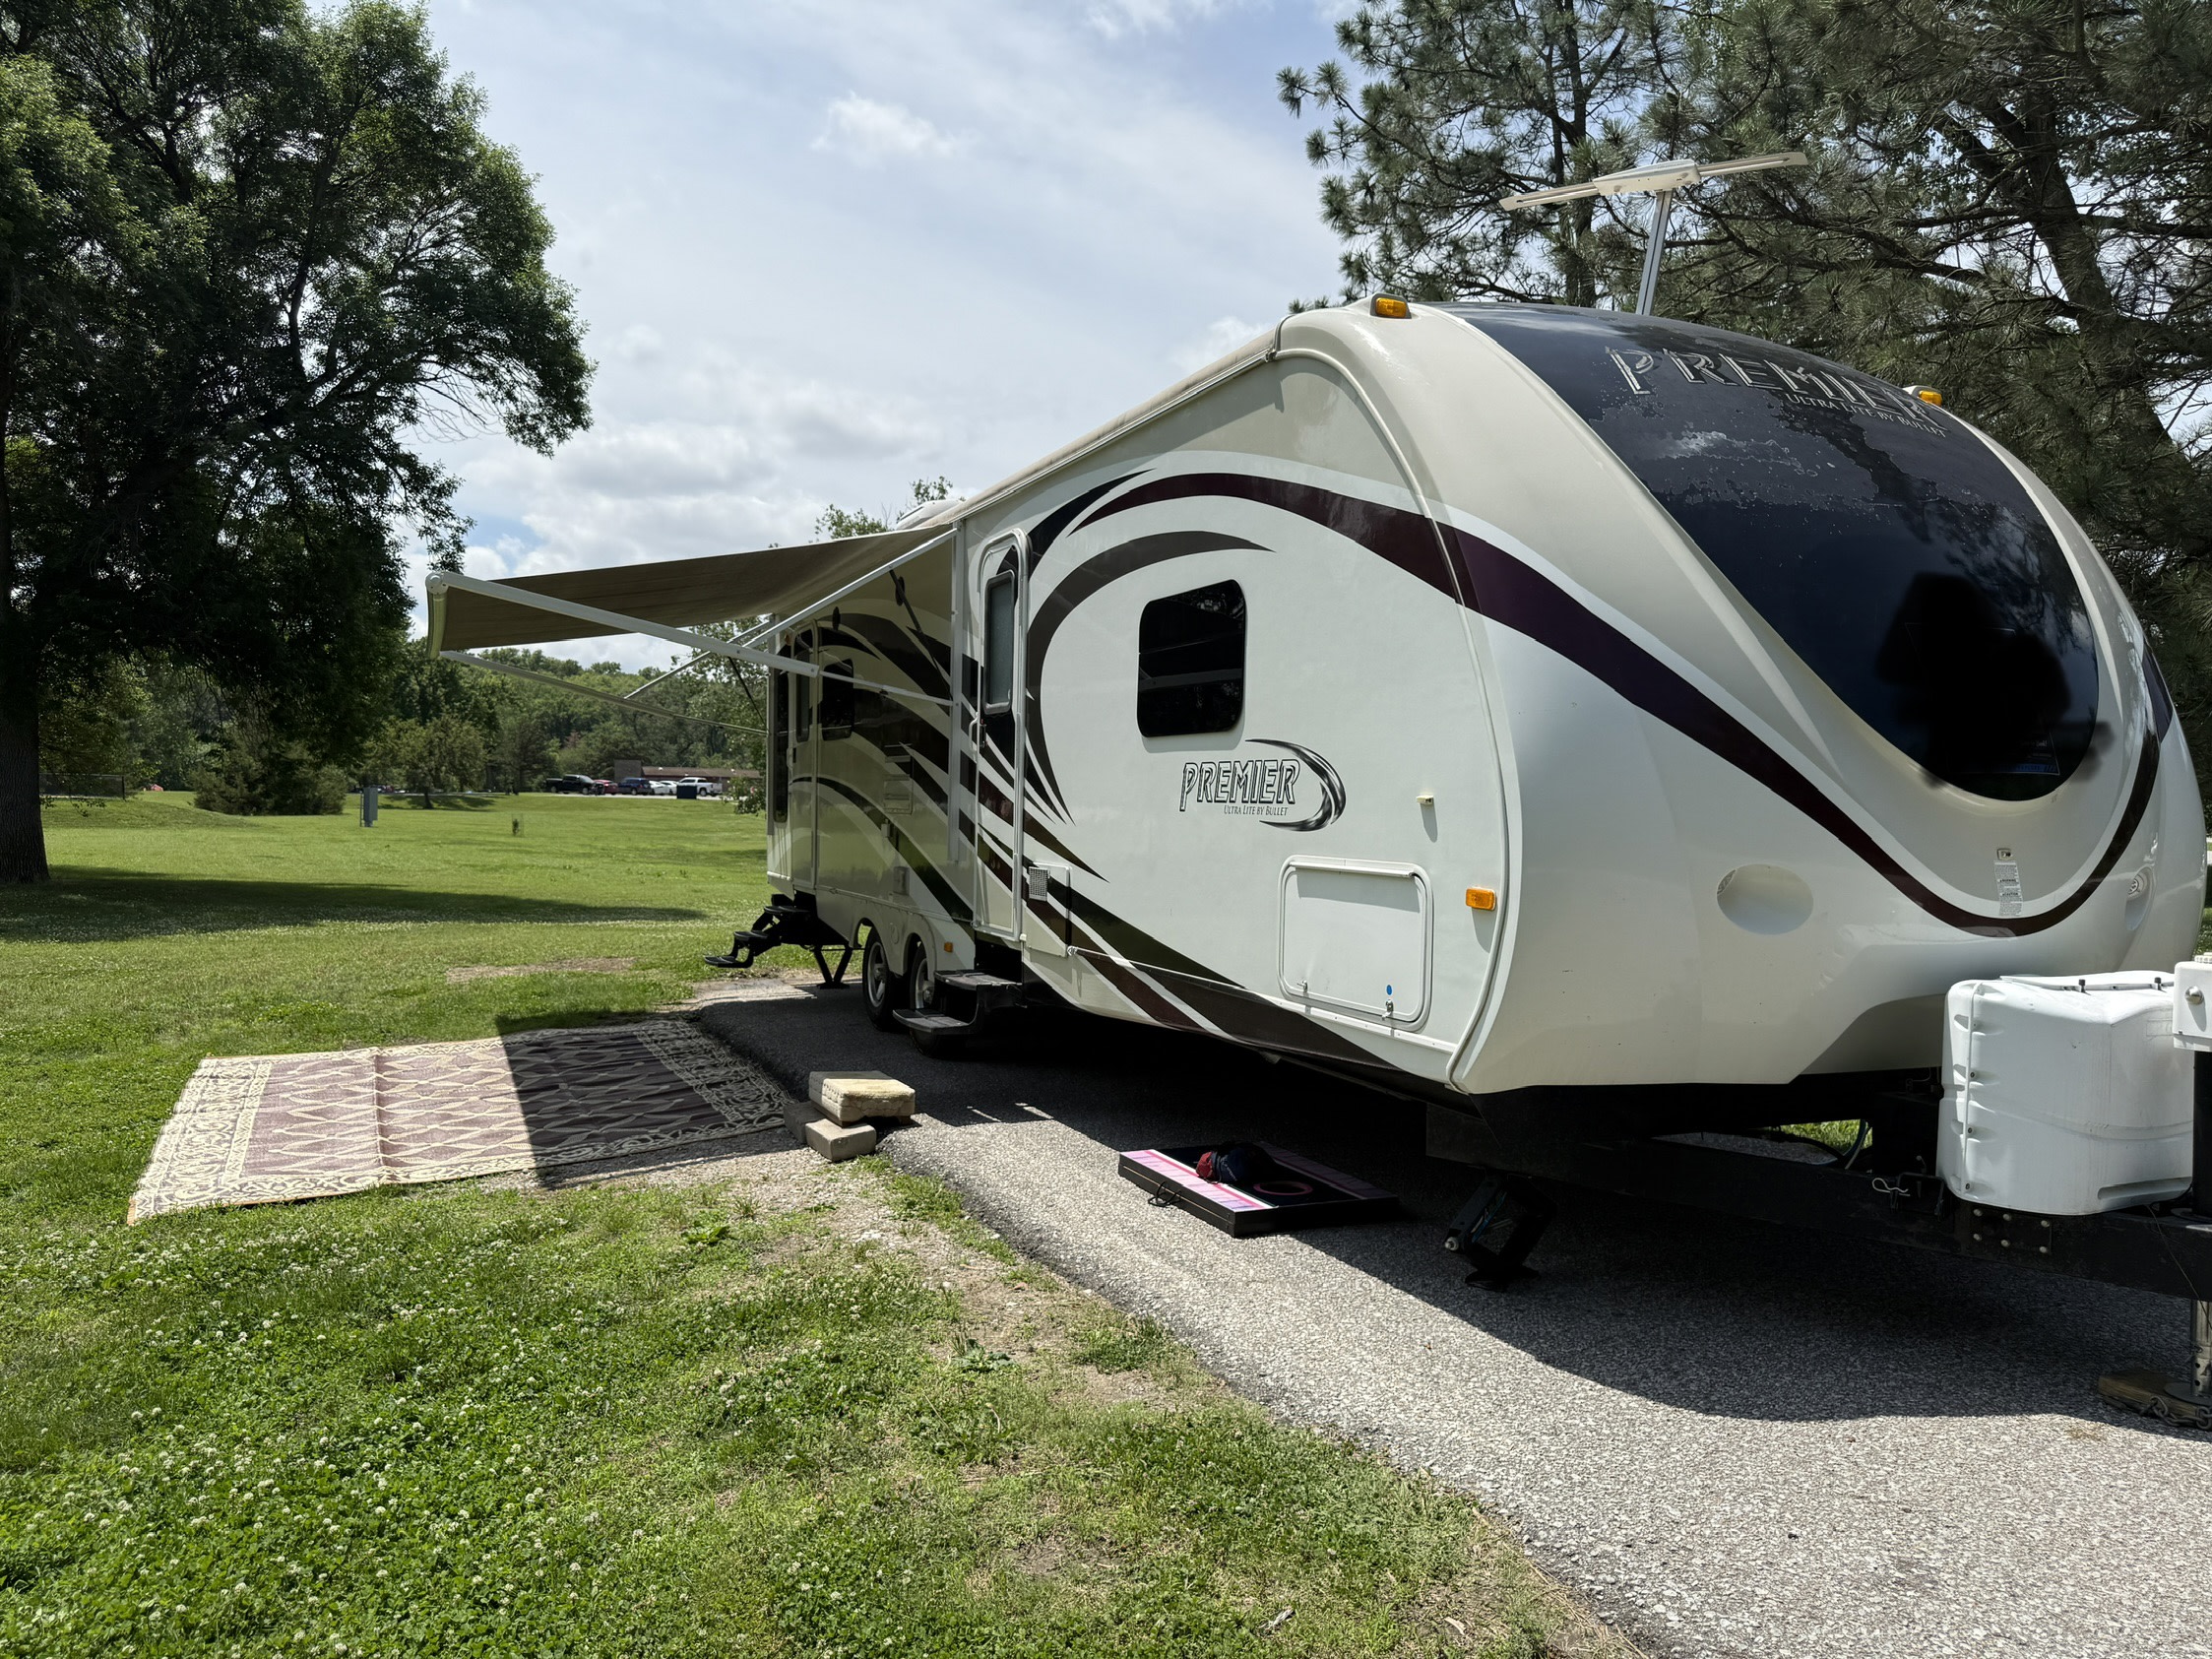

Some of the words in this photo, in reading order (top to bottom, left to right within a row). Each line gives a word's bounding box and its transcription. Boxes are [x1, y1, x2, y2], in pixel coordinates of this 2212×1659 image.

[1605, 347, 1950, 431] PREMIER
[1785, 393, 1841, 411] ULTRA
[1840, 402, 1876, 416] LITE
[1877, 412, 1894, 421] BY
[1179, 759, 1300, 811] PREMIER
[1224, 804, 1241, 815] ULTRA
[1242, 804, 1256, 815] LITE
[1266, 805, 1289, 816] BULLET
